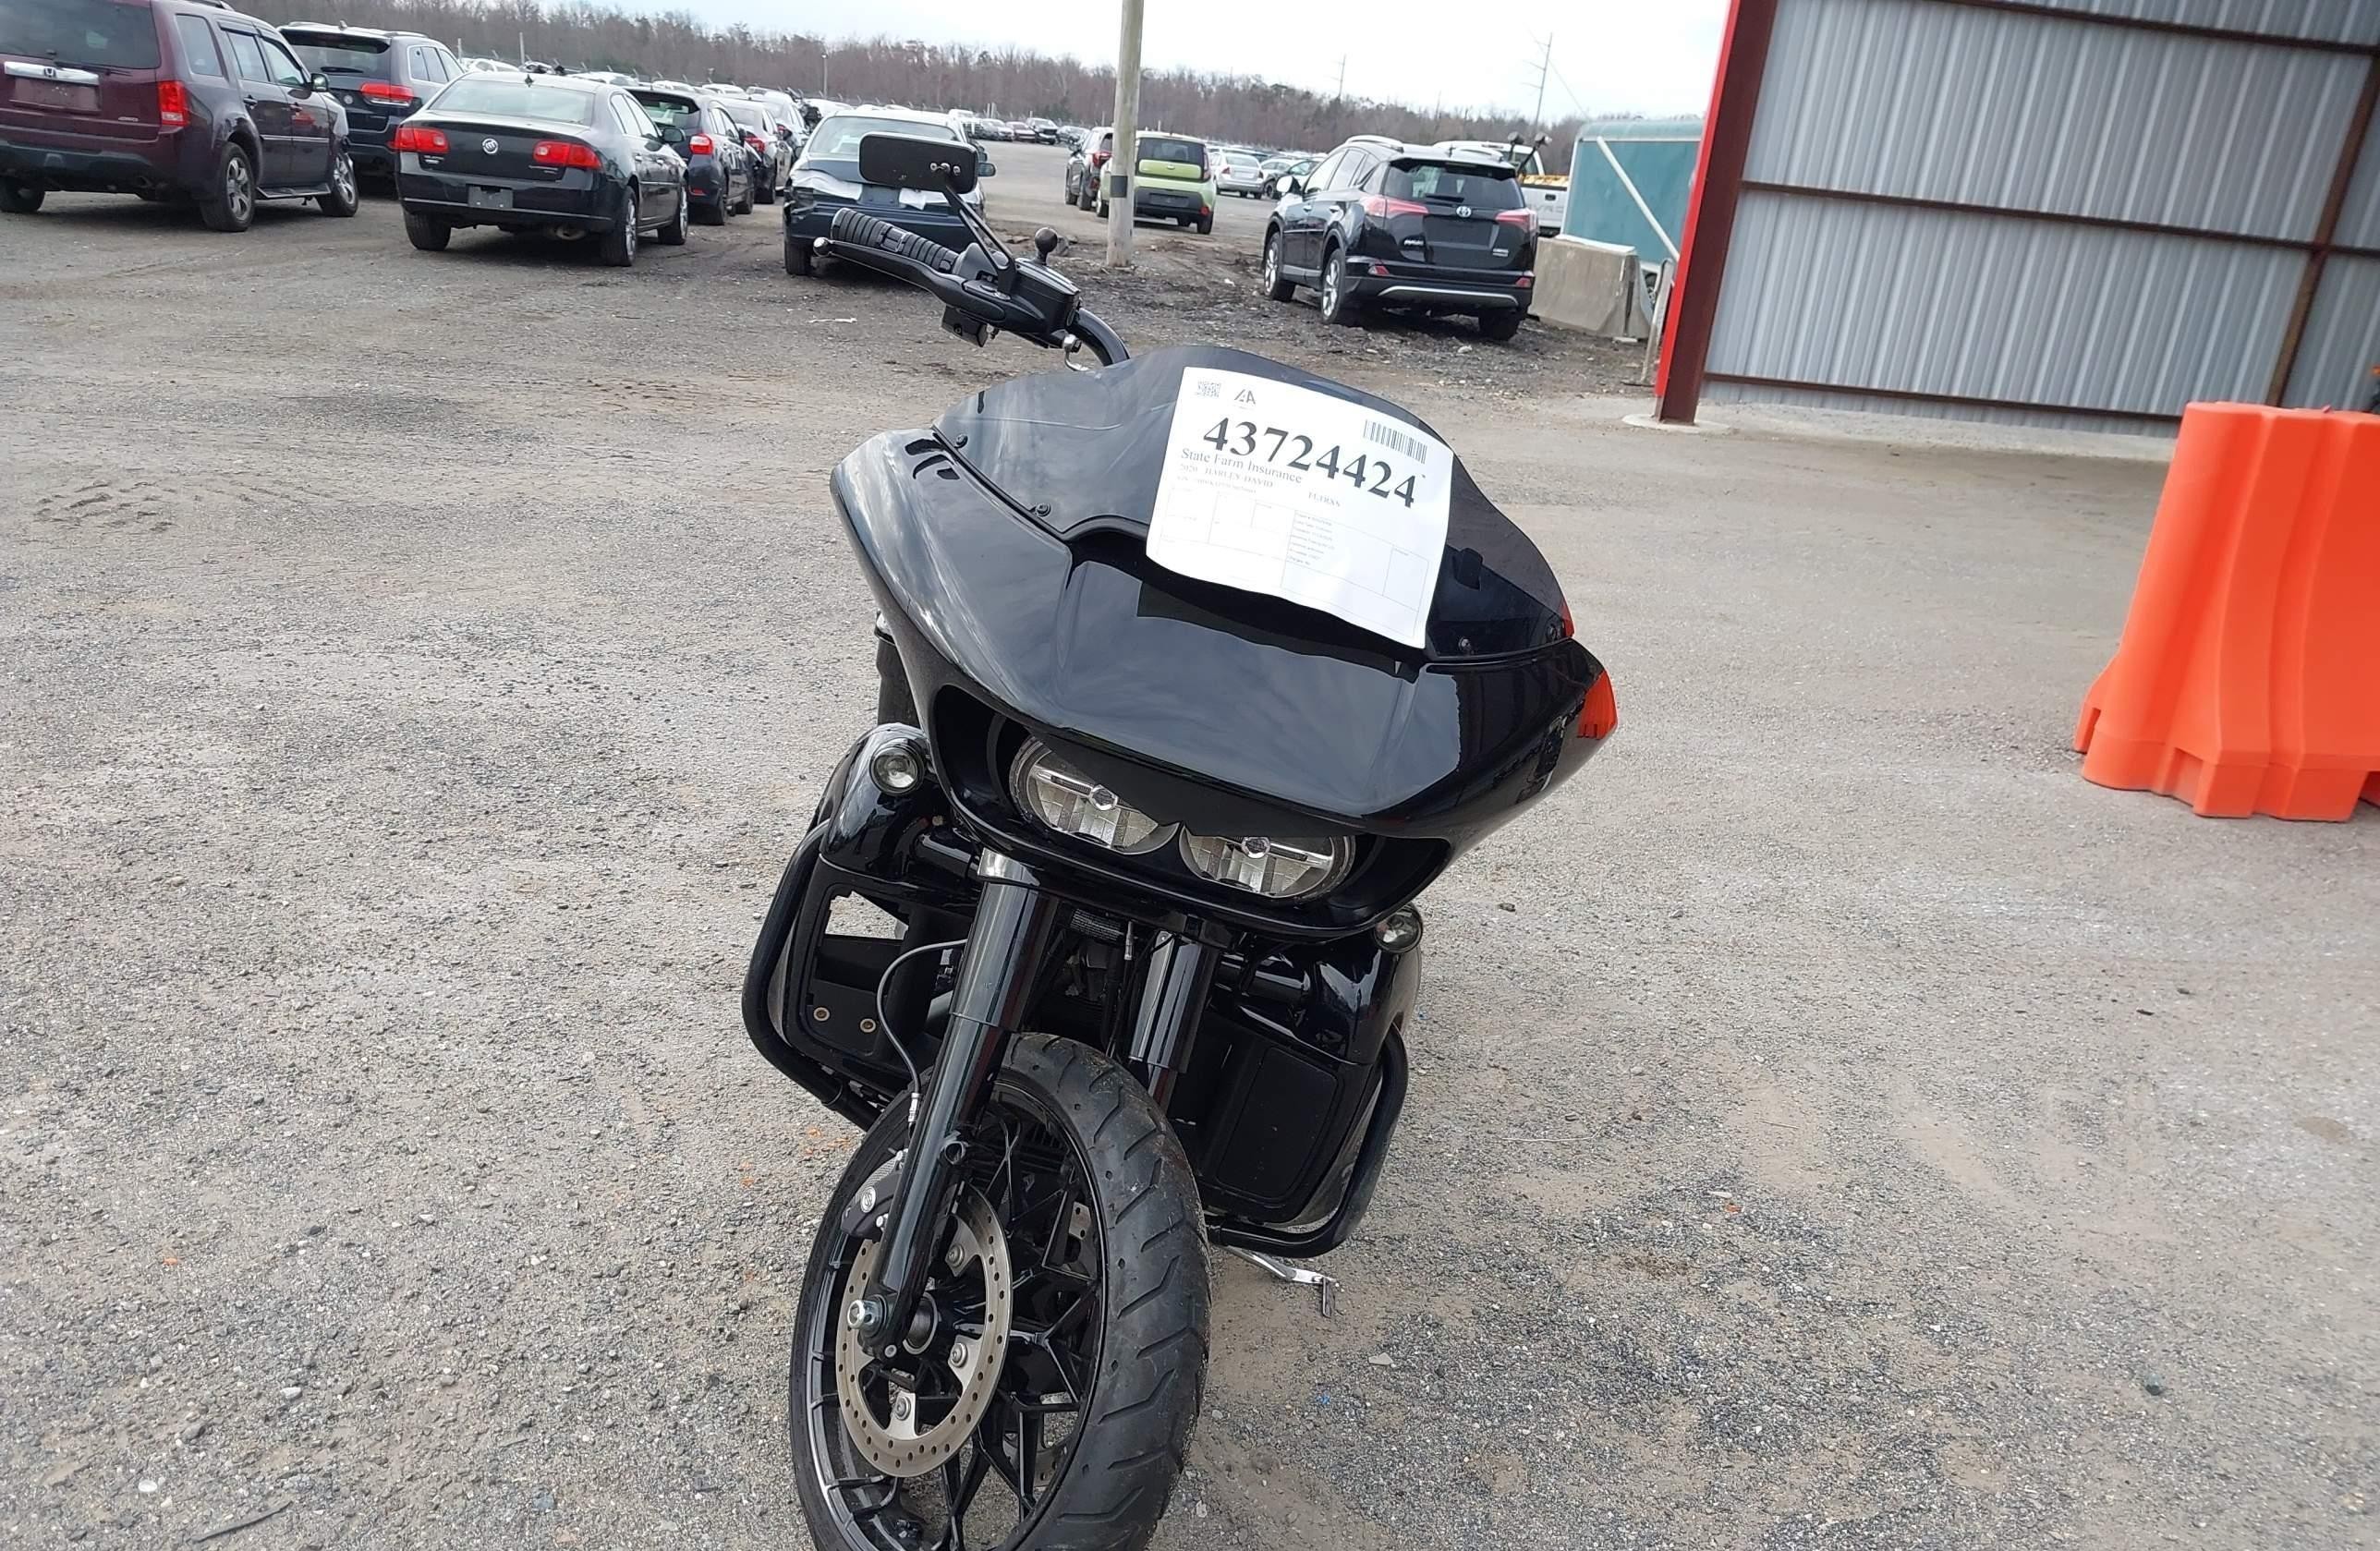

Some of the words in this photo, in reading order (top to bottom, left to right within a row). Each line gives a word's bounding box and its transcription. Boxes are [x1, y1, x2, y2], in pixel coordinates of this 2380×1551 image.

[1181, 447, 1211, 464] State
[1214, 453, 1244, 470] Farm
[1247, 459, 1302, 484] Insurance
[1203, 418, 1415, 508] 43724424
